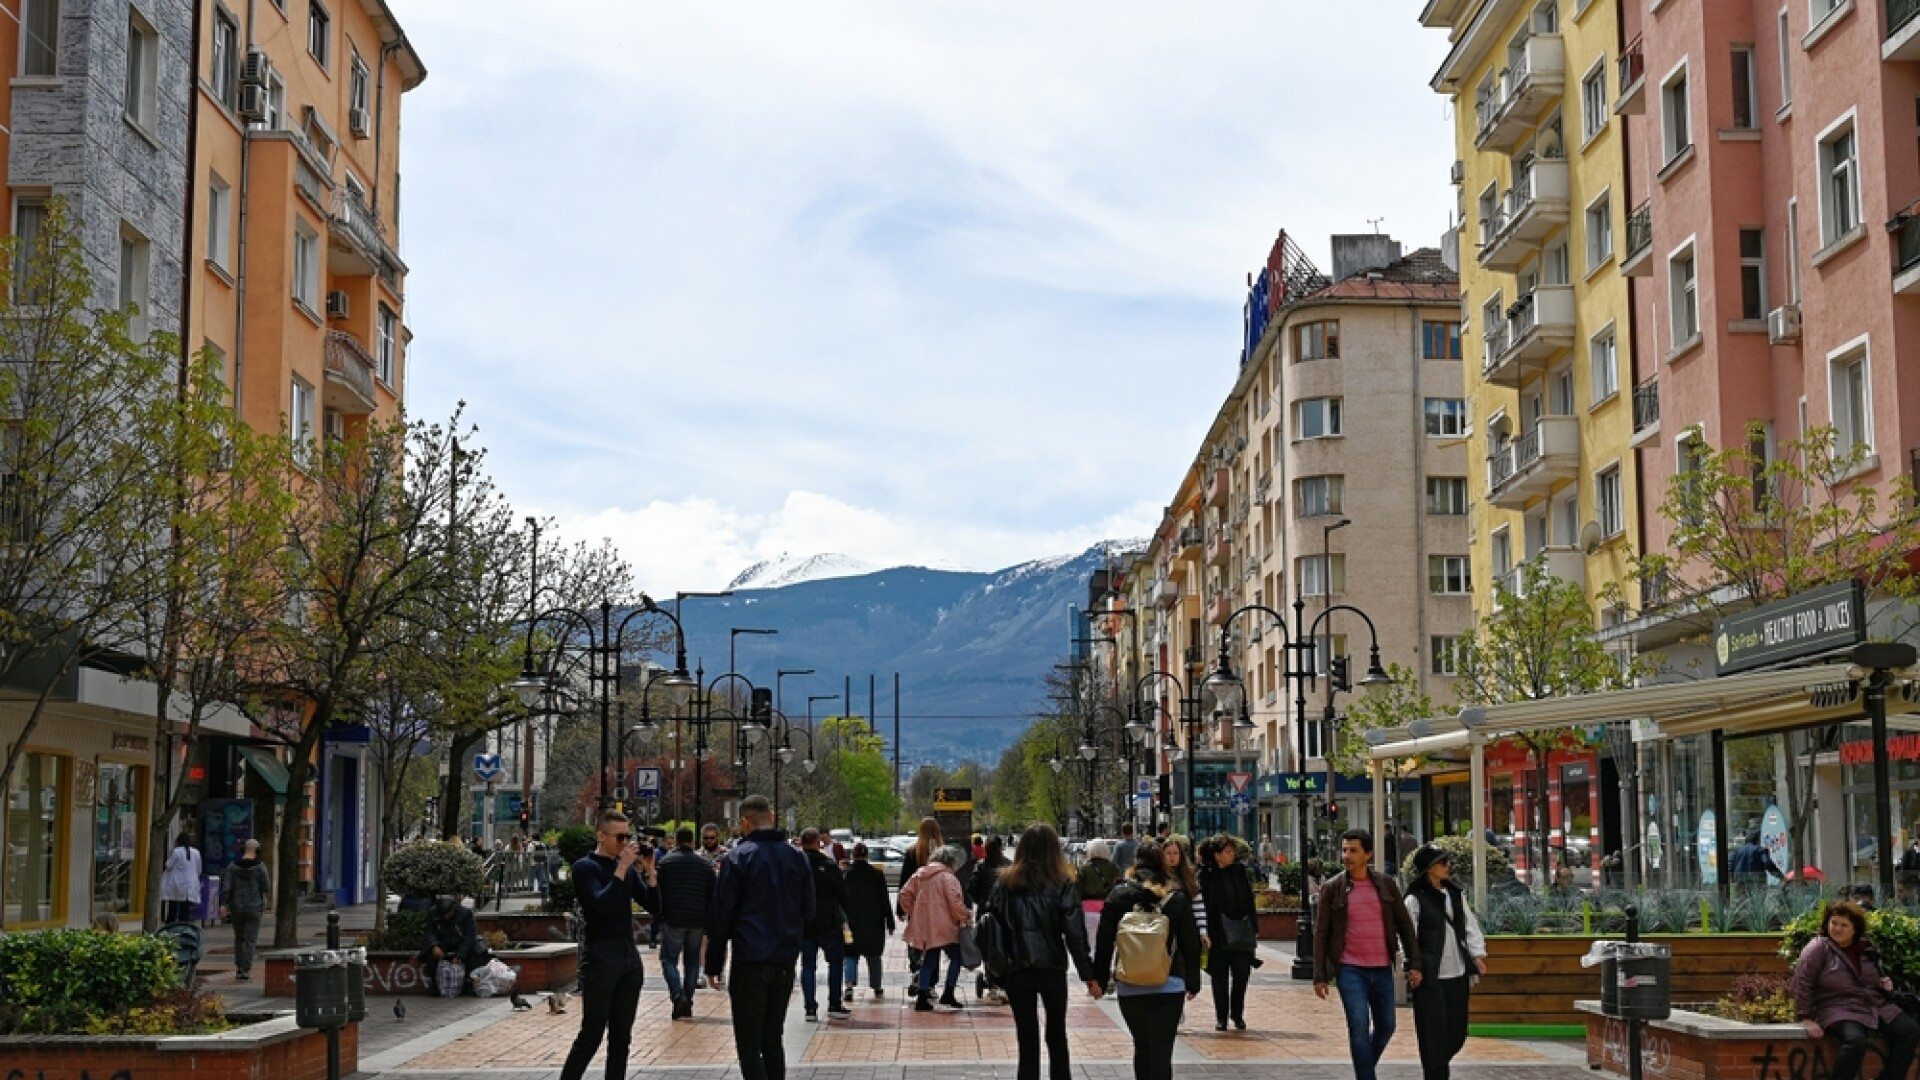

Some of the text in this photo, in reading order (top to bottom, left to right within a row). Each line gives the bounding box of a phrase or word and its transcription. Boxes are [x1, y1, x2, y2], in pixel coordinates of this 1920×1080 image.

[1763, 615, 1794, 646] HEALTHY
[1796, 609, 1817, 638] FOOD
[1823, 600, 1850, 633] JUICES
